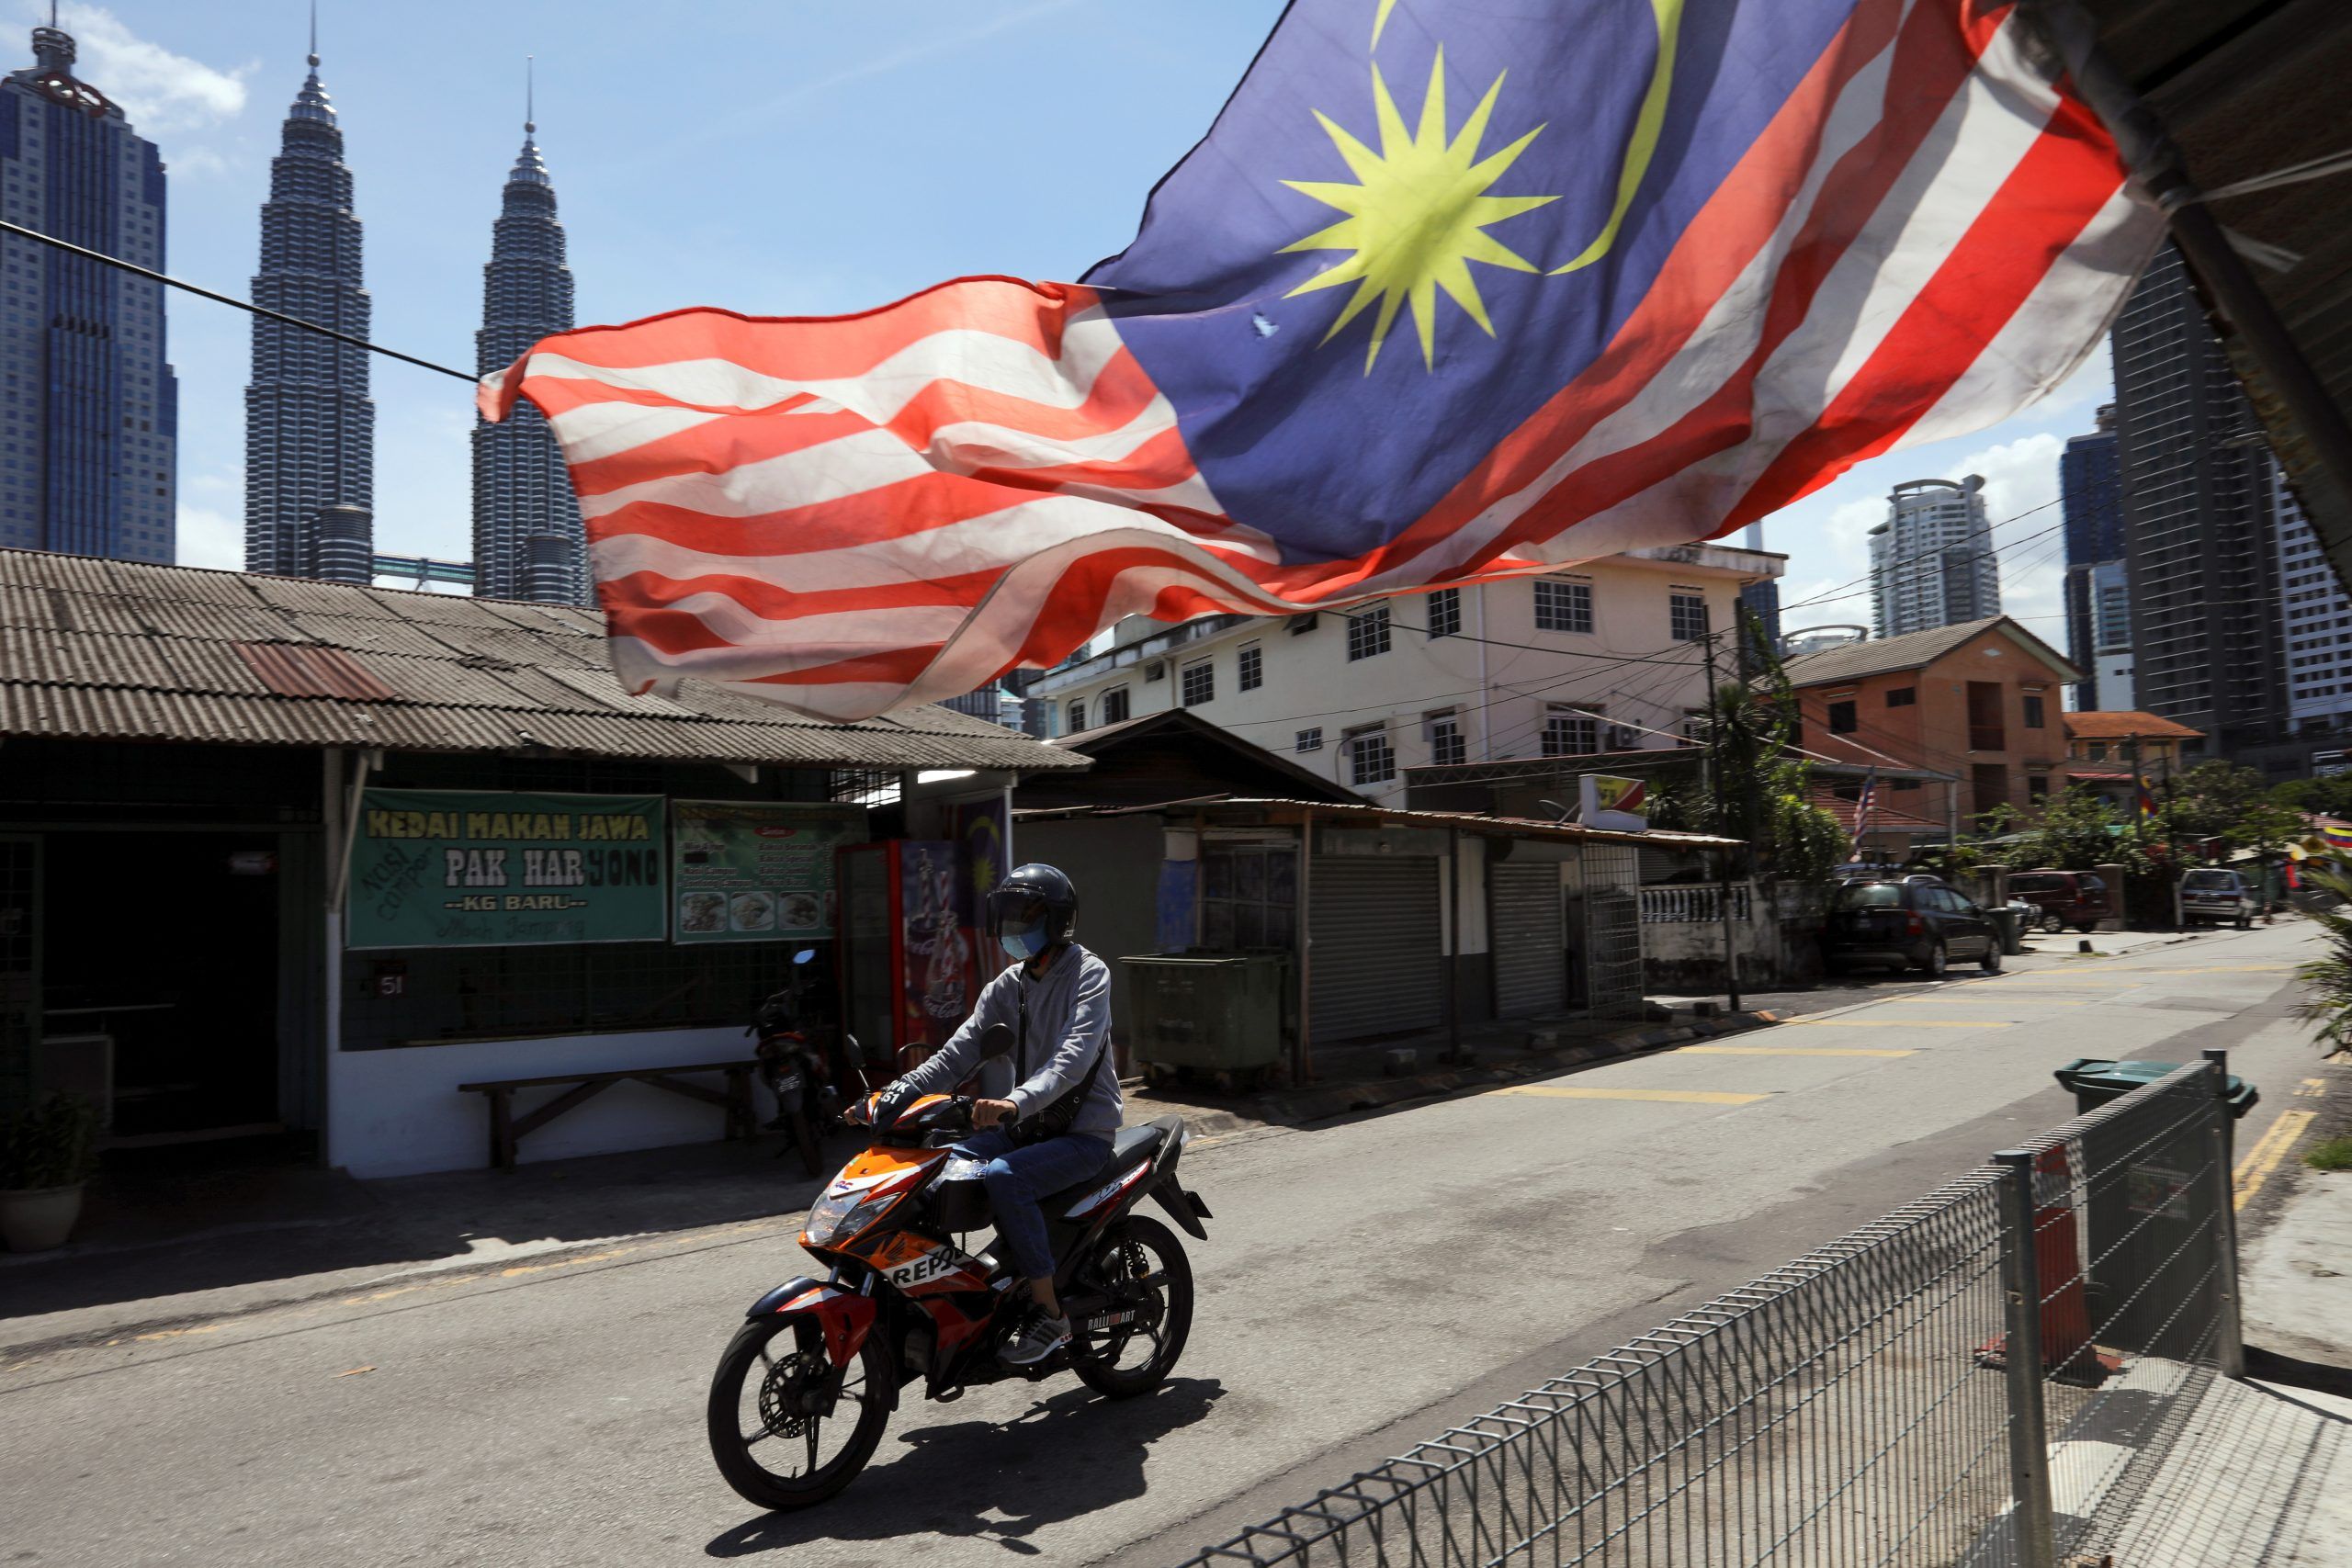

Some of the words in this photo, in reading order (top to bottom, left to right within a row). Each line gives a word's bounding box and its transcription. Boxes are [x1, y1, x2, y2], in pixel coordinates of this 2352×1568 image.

[367, 809, 460, 840] KEDAI
[466, 811, 571, 840] MAKAN
[577, 814, 650, 840] JAWA
[444, 848, 507, 887] PAK
[381, 976, 401, 994] 51
